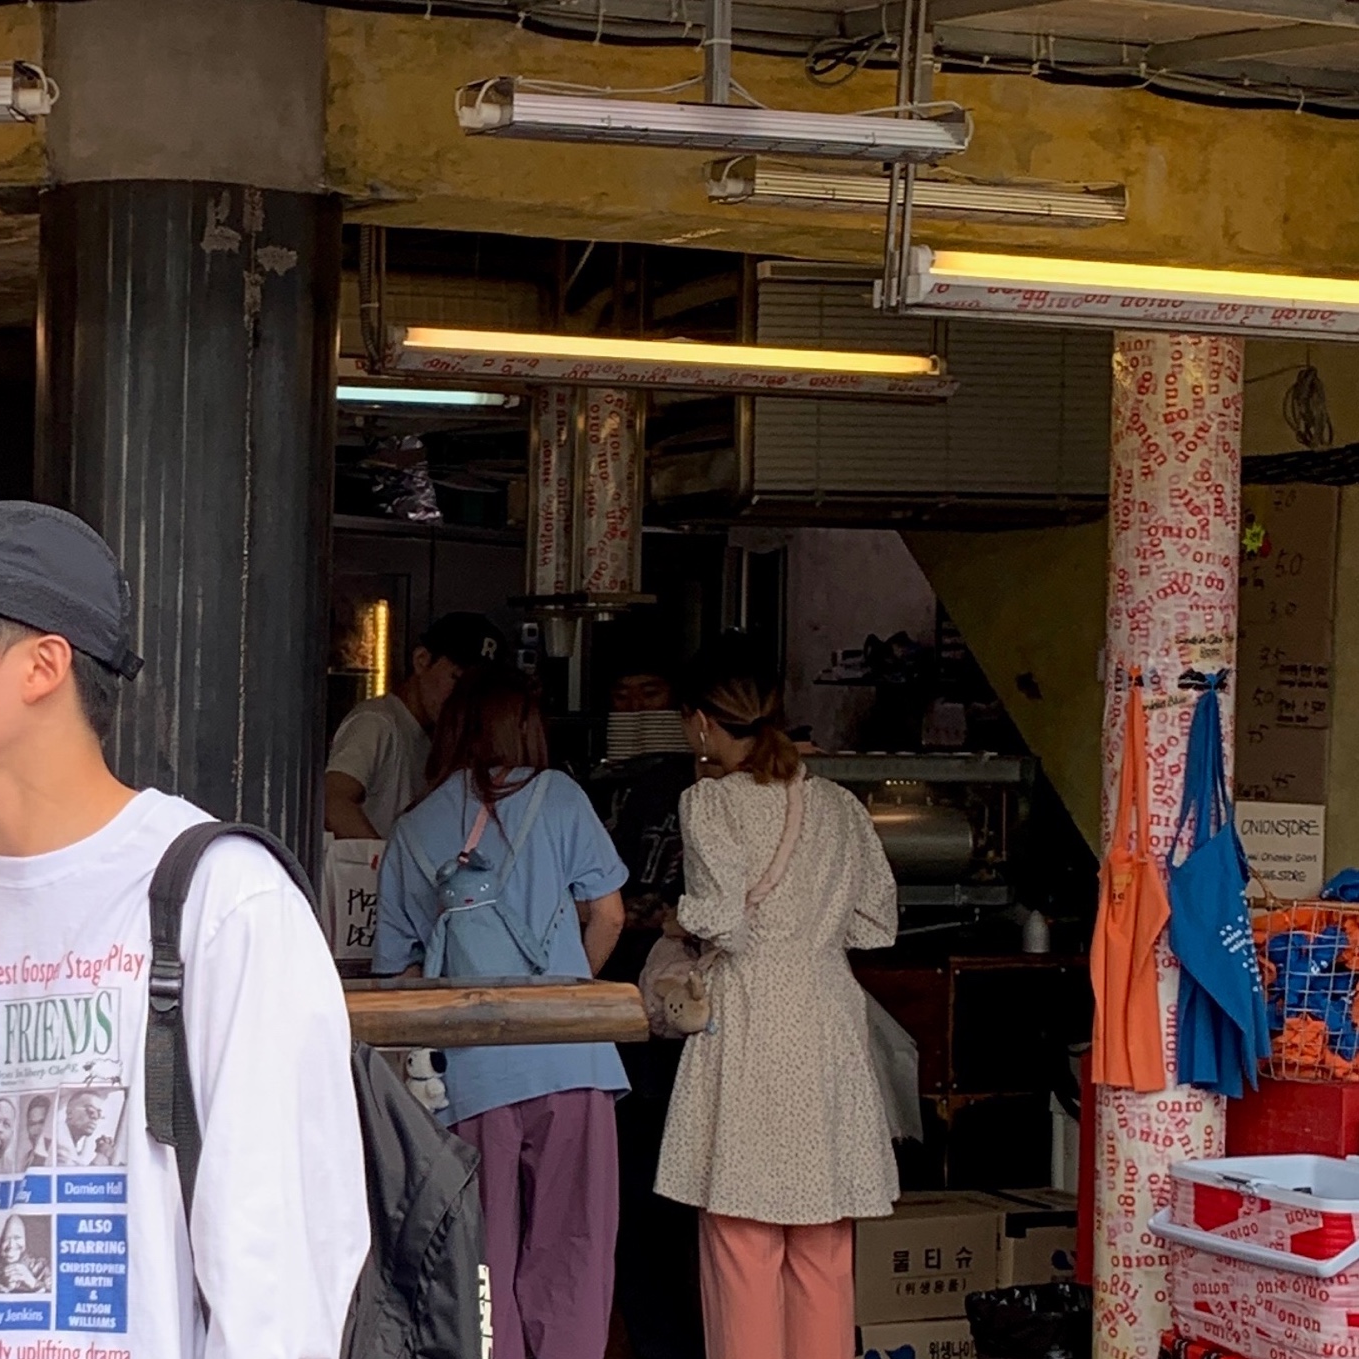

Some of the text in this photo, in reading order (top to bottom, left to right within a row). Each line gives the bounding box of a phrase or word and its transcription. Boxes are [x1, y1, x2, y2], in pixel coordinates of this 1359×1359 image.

[106, 943, 145, 981] Play
[4, 989, 113, 1065] FRIENDS
[77, 1218, 113, 1234] ALSO
[60, 1240, 126, 1255] STARRING
[59, 1261, 126, 1275] CHRISTOPHER
[74, 1276, 113, 1288] MARTIN
[5, 1308, 44, 1323] Jenkins
[74, 1303, 112, 1315] ALYSON
[68, 1316, 117, 1329] WILLIAMS
